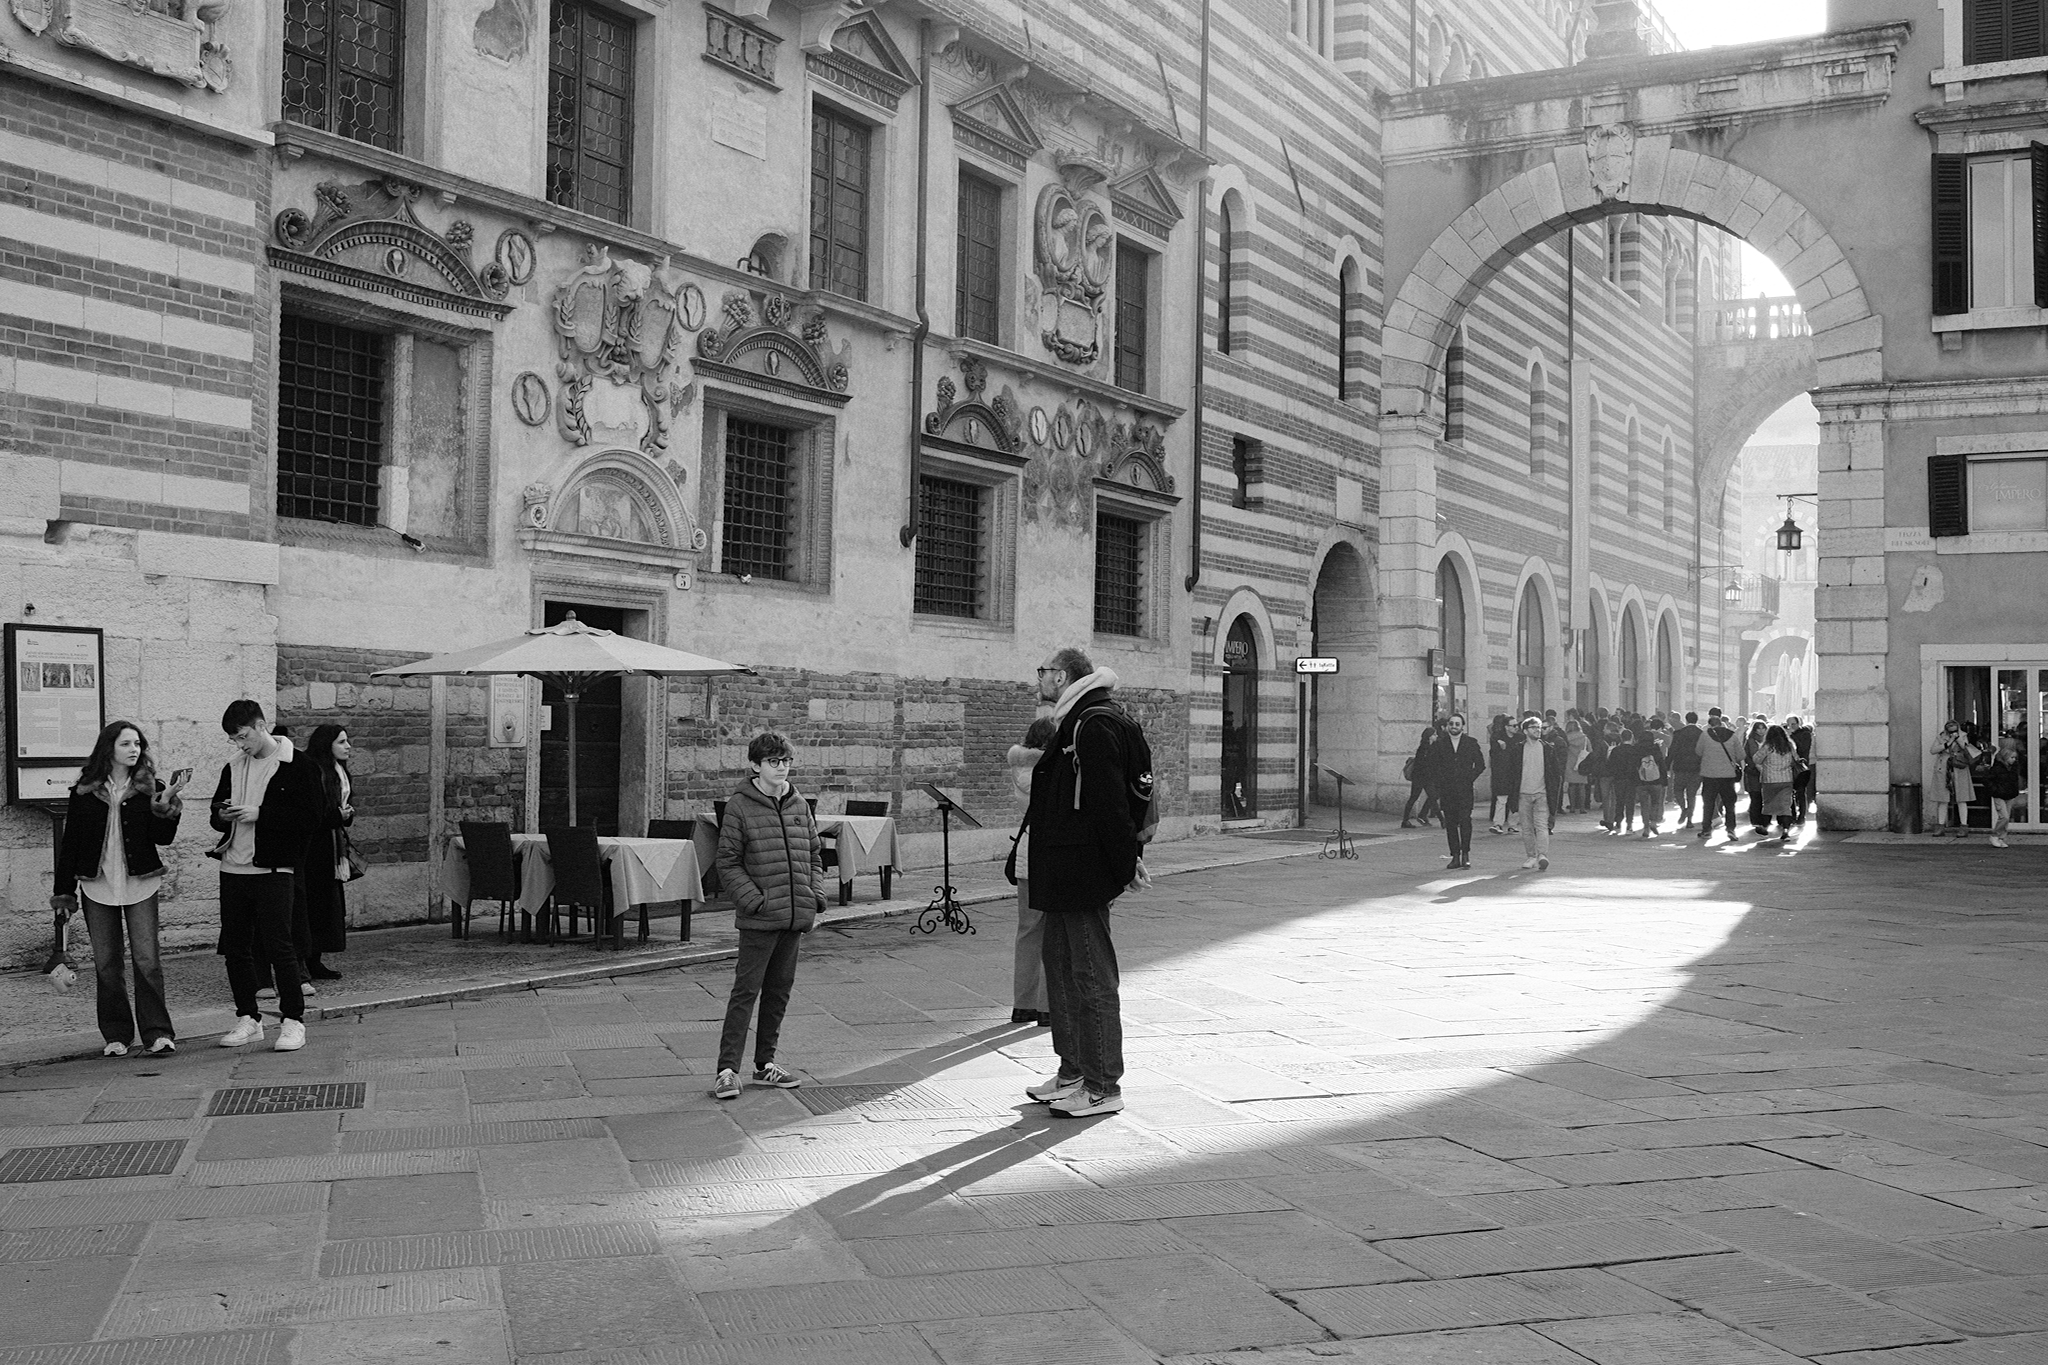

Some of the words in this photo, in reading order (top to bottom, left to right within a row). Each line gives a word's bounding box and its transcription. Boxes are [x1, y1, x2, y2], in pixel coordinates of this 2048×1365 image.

[1577, 383, 1587, 433] RAGIONE
[1577, 435, 1587, 460] della
[1578, 462, 1587, 508] PALAZZO
[680, 575, 687, 587] 5
